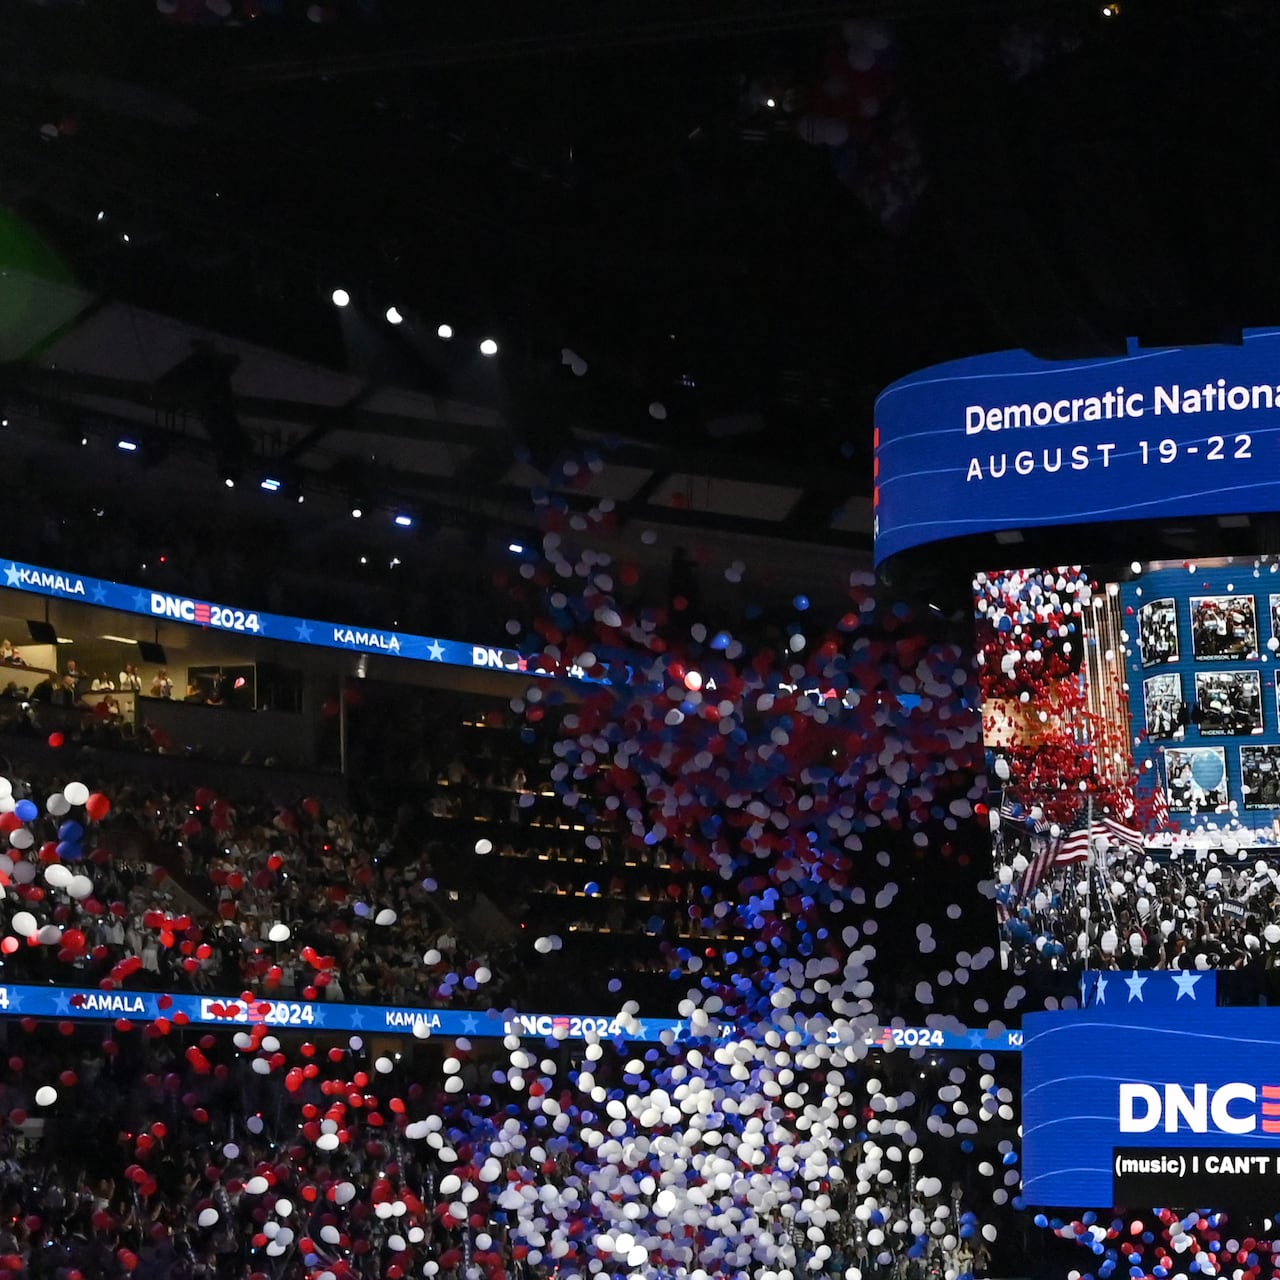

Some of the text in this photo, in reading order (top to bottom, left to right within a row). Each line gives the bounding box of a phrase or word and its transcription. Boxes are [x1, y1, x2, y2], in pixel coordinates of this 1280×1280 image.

[965, 386, 1144, 435] Democratic
[966, 443, 1117, 482] AUGUST
[1139, 434, 1253, 464] 19-22
[20, 568, 85, 595] KAMALA
[210, 606, 259, 632] 2024
[334, 628, 400, 650] KAMALA
[386, 1011, 441, 1028] KAMALA
[570, 1018, 621, 1037] 2024
[892, 1029, 944, 1046] 2024
[1119, 1083, 1256, 1134] DNC
[1115, 1156, 1186, 1177] (music)
[1193, 1157, 1199, 1174] I
[1205, 1156, 1271, 1175] CAN'T
